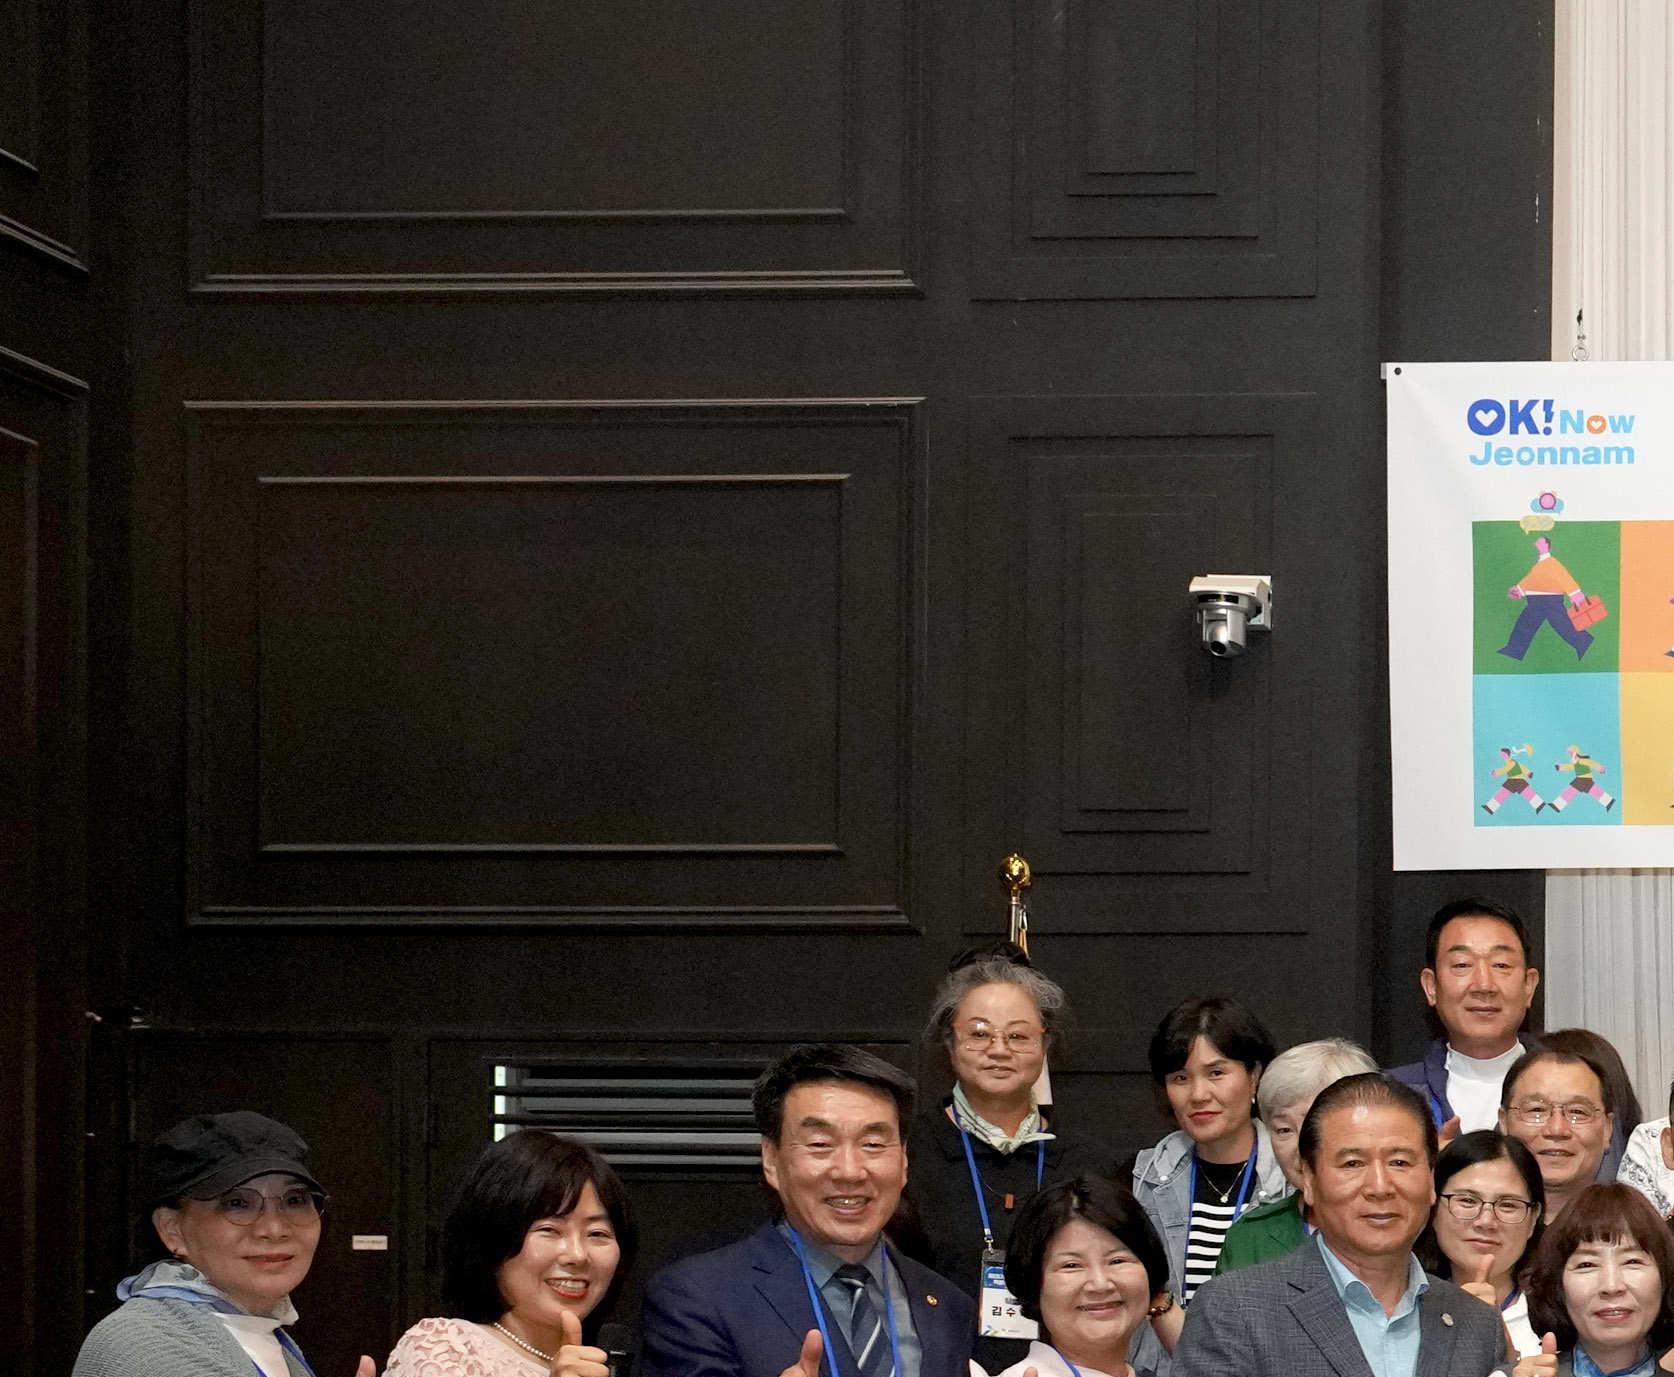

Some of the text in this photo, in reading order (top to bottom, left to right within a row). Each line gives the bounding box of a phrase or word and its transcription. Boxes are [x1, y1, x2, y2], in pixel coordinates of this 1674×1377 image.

[1467, 399, 1635, 436] OK! Now
[1470, 442, 1635, 466] Jeonnam
